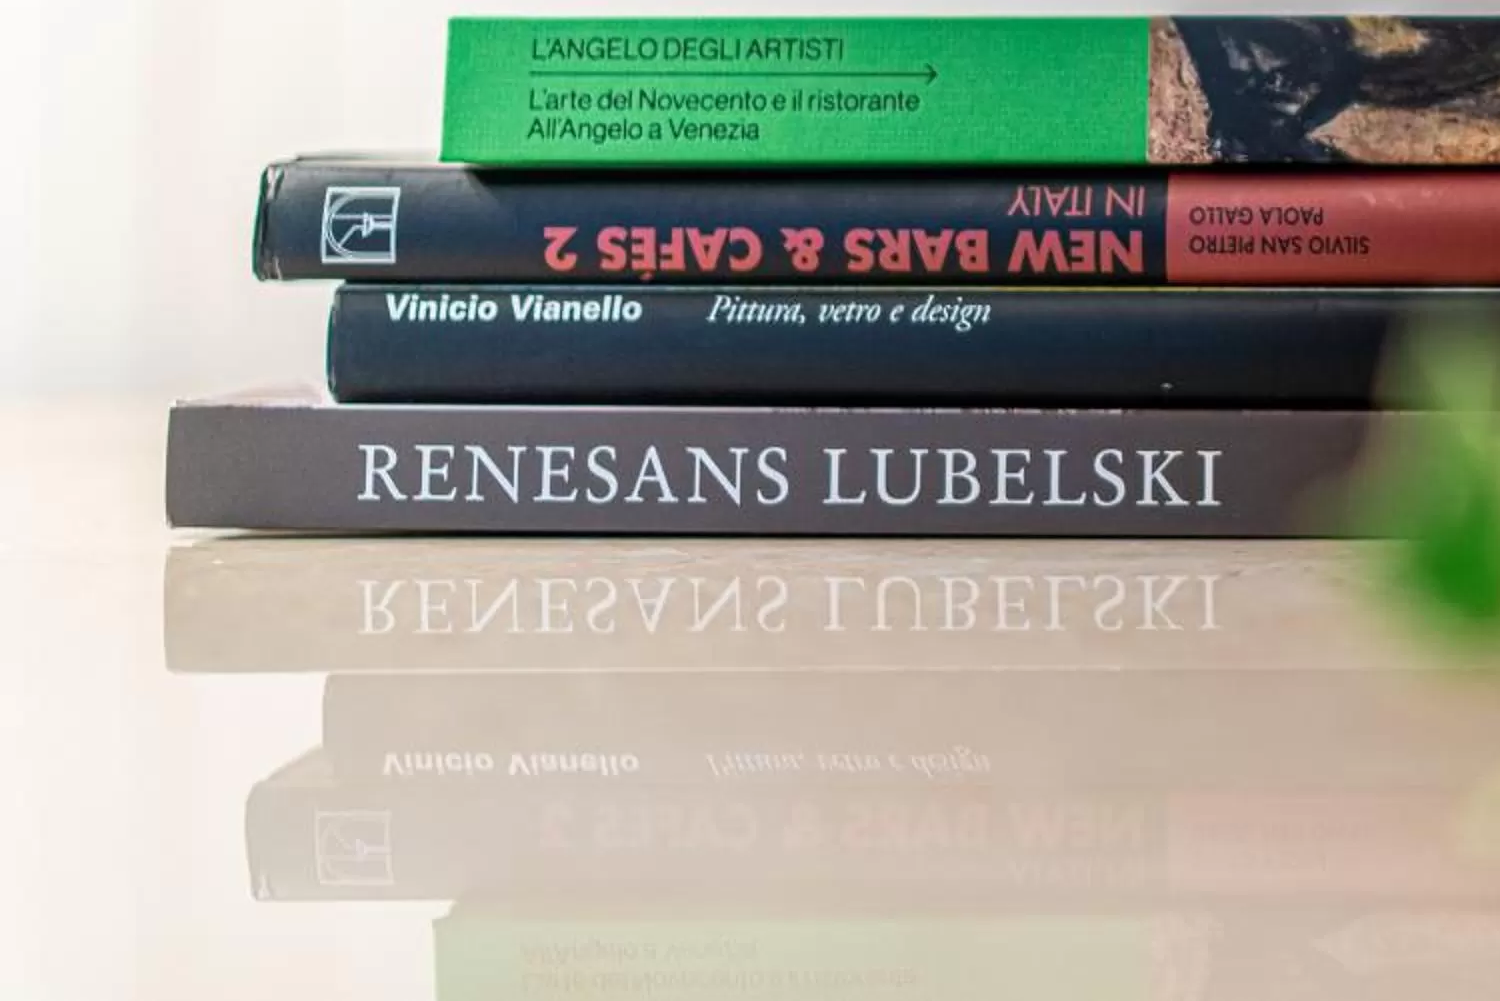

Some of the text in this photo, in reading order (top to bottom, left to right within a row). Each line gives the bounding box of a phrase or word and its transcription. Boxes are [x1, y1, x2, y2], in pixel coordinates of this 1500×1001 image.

[532, 37, 844, 61] L'ANGELO DEGLI ARTISTI
[529, 89, 920, 112] L'arte del Novecento e il ristorante
[527, 118, 760, 144] All'Angelo a Venezia
[1007, 183, 1146, 216] IN ITALY
[1189, 206, 1324, 226] PAOLA GALLO
[543, 225, 1143, 283] NEW BARS & CAFÉS 2
[1188, 236, 1370, 255] SILVIO SAN PIETRO
[385, 293, 643, 322] Vinicio Vianello
[706, 295, 993, 332] Pittura, vetro e design
[357, 444, 1224, 507] RENESANS LUBELSKI
